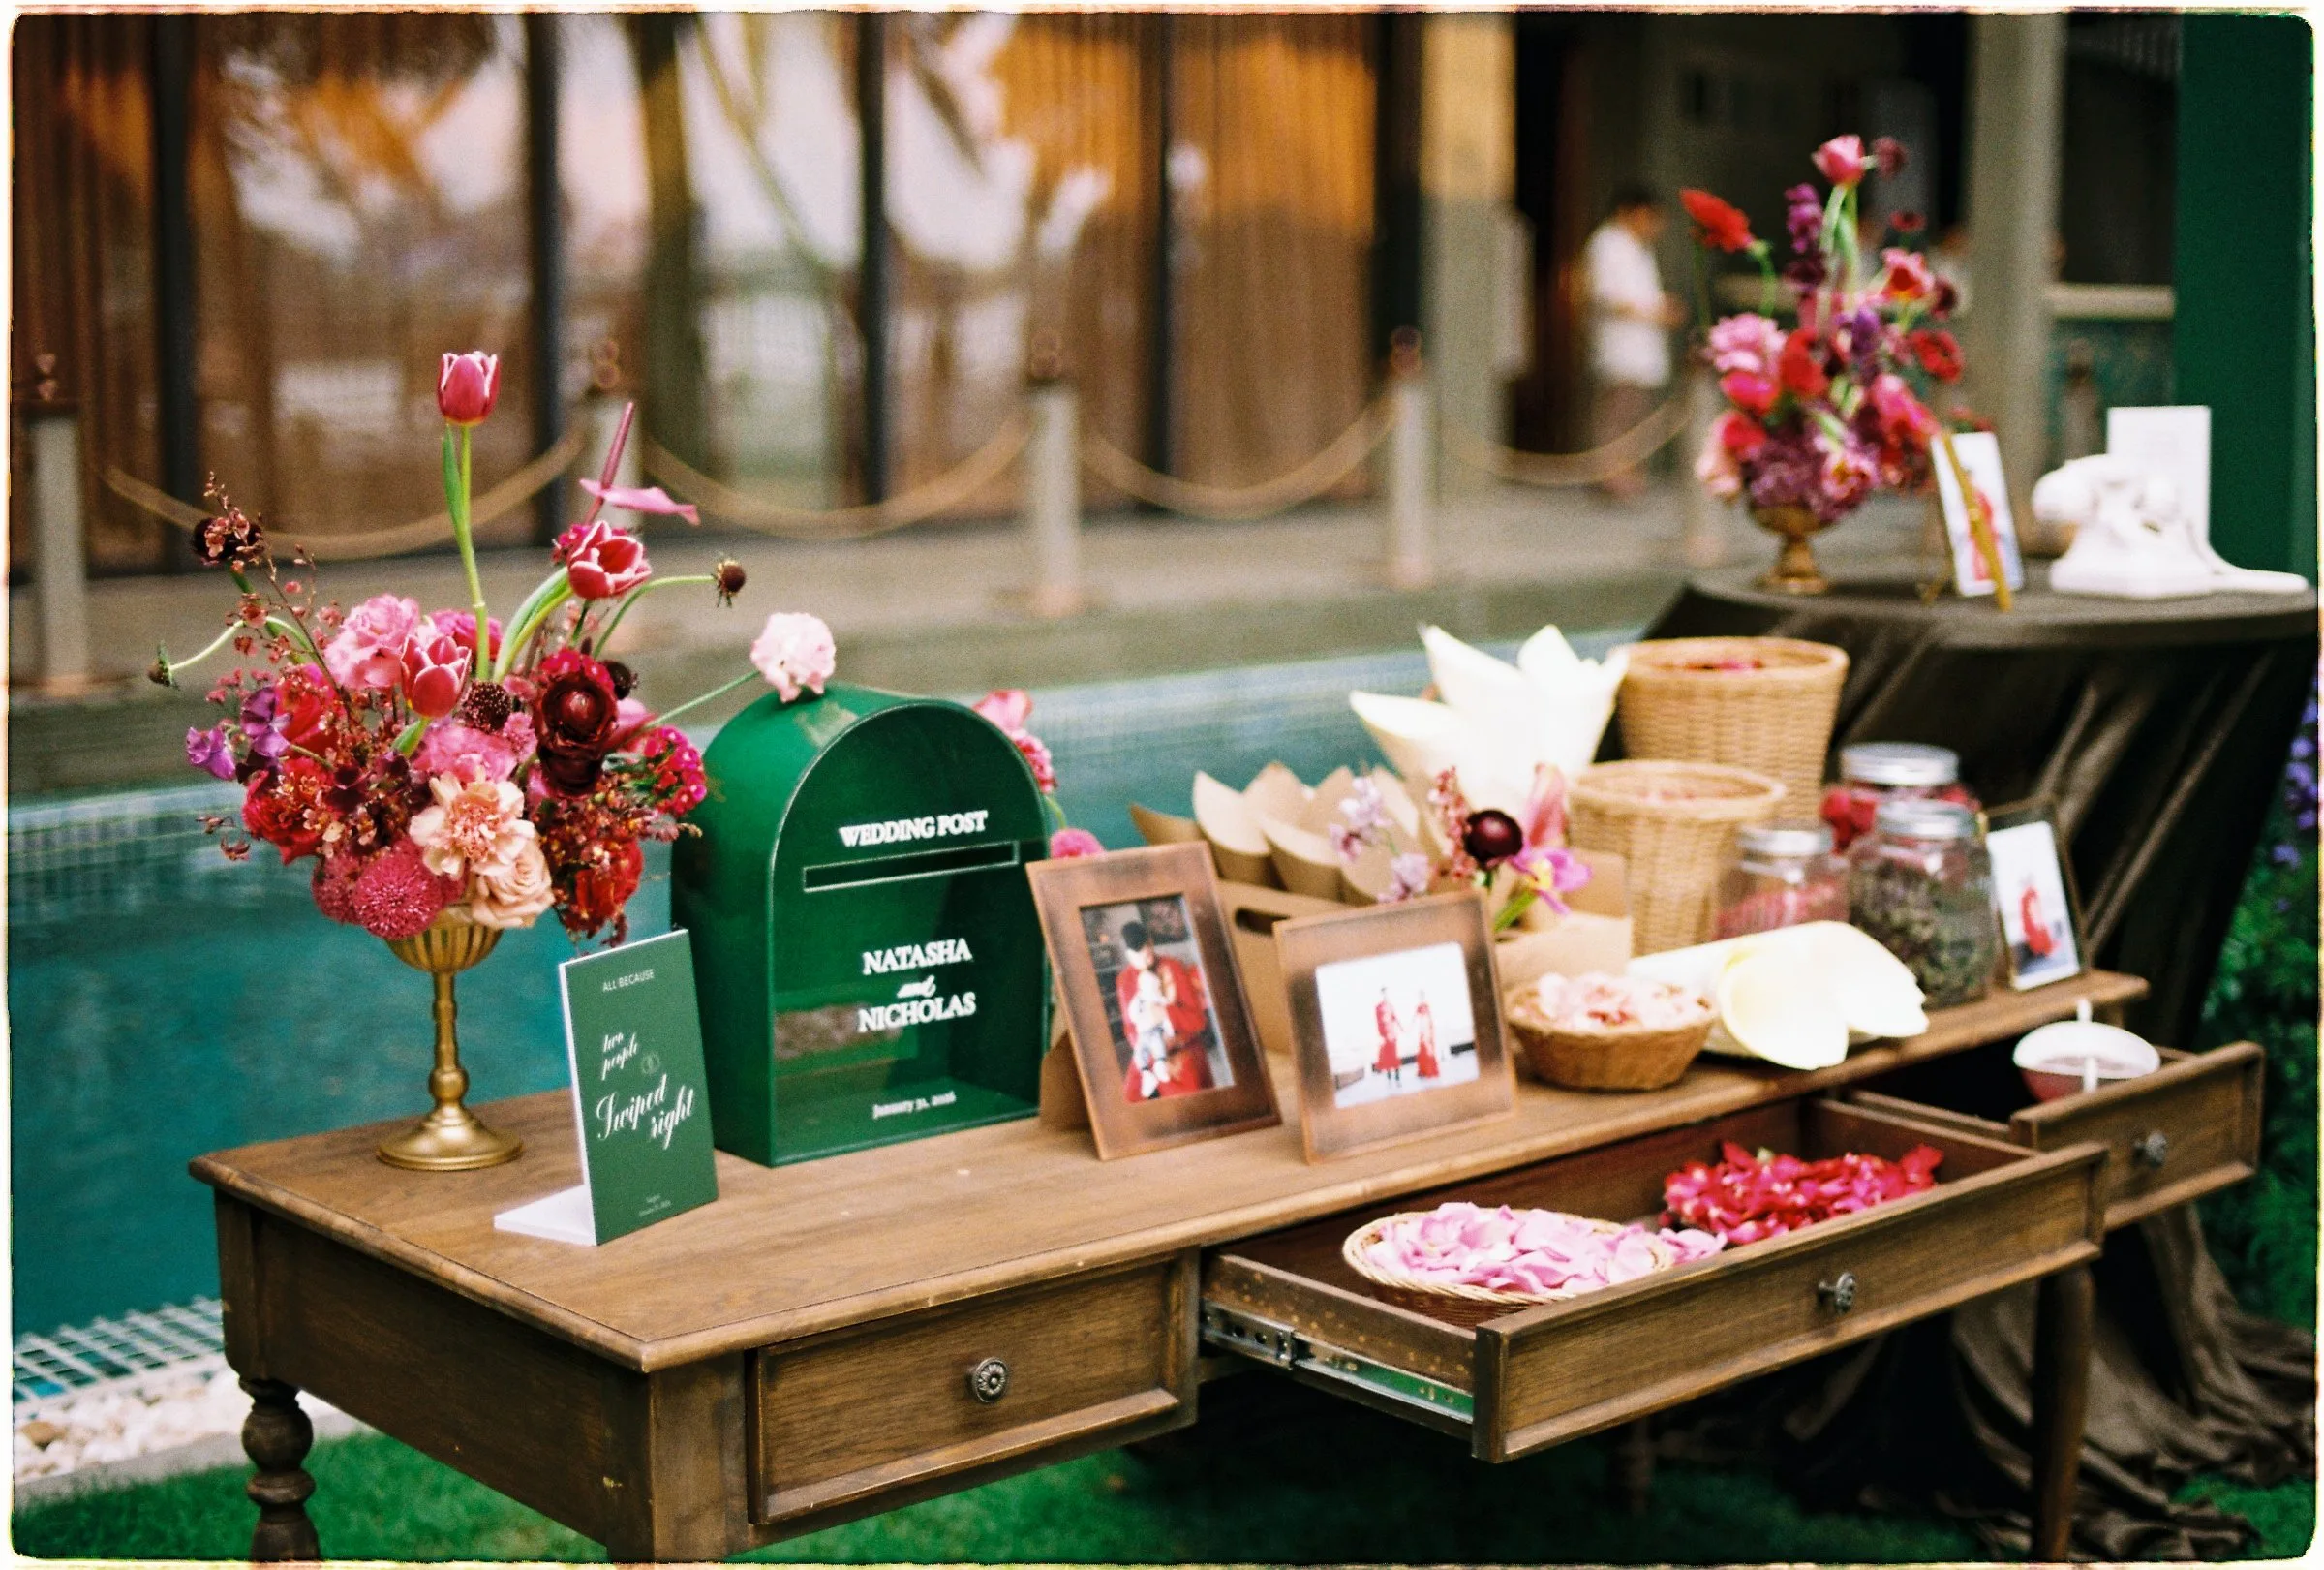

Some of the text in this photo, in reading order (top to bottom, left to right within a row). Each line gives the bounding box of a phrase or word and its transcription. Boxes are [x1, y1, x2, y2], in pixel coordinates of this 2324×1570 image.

[839, 810, 989, 847] WEDDING POST
[862, 938, 973, 975] NATASHA
[602, 968, 655, 993] ALL BECAUSE
[858, 991, 977, 1033] NICHOLAS
[601, 1032, 638, 1081] people
[651, 1085, 694, 1150] right
